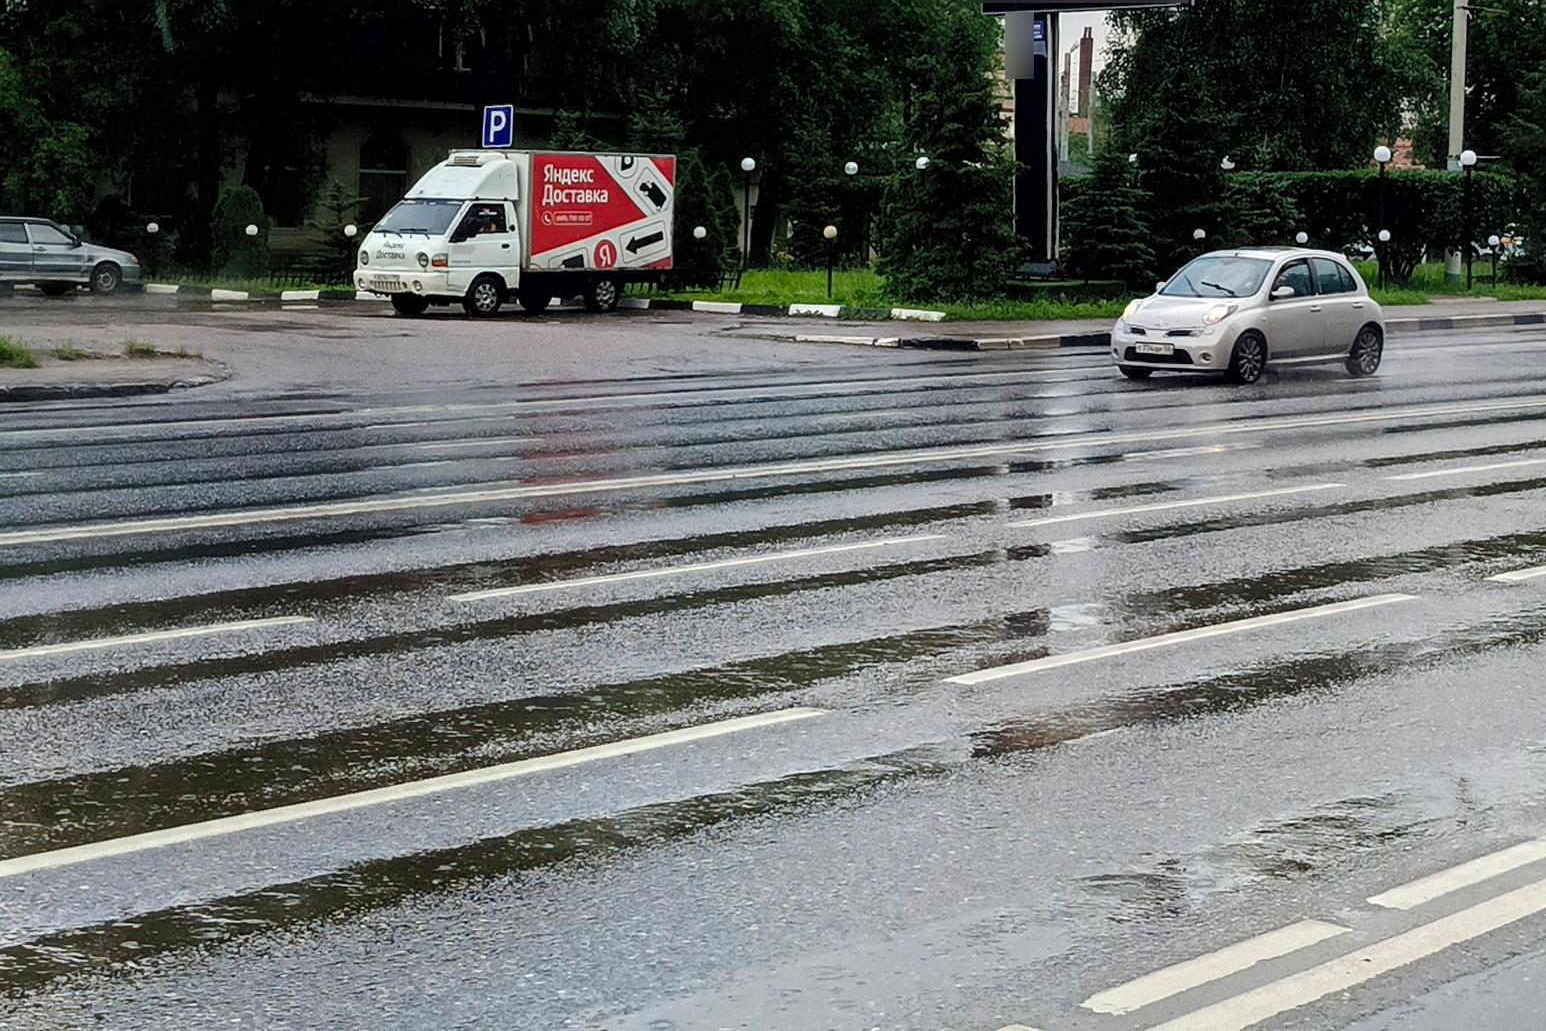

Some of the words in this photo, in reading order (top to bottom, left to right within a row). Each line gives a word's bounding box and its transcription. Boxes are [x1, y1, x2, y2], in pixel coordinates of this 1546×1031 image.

[490, 110, 507, 142] P
[543, 163, 595, 185] Яндекс
[541, 184, 609, 206] Доставка
